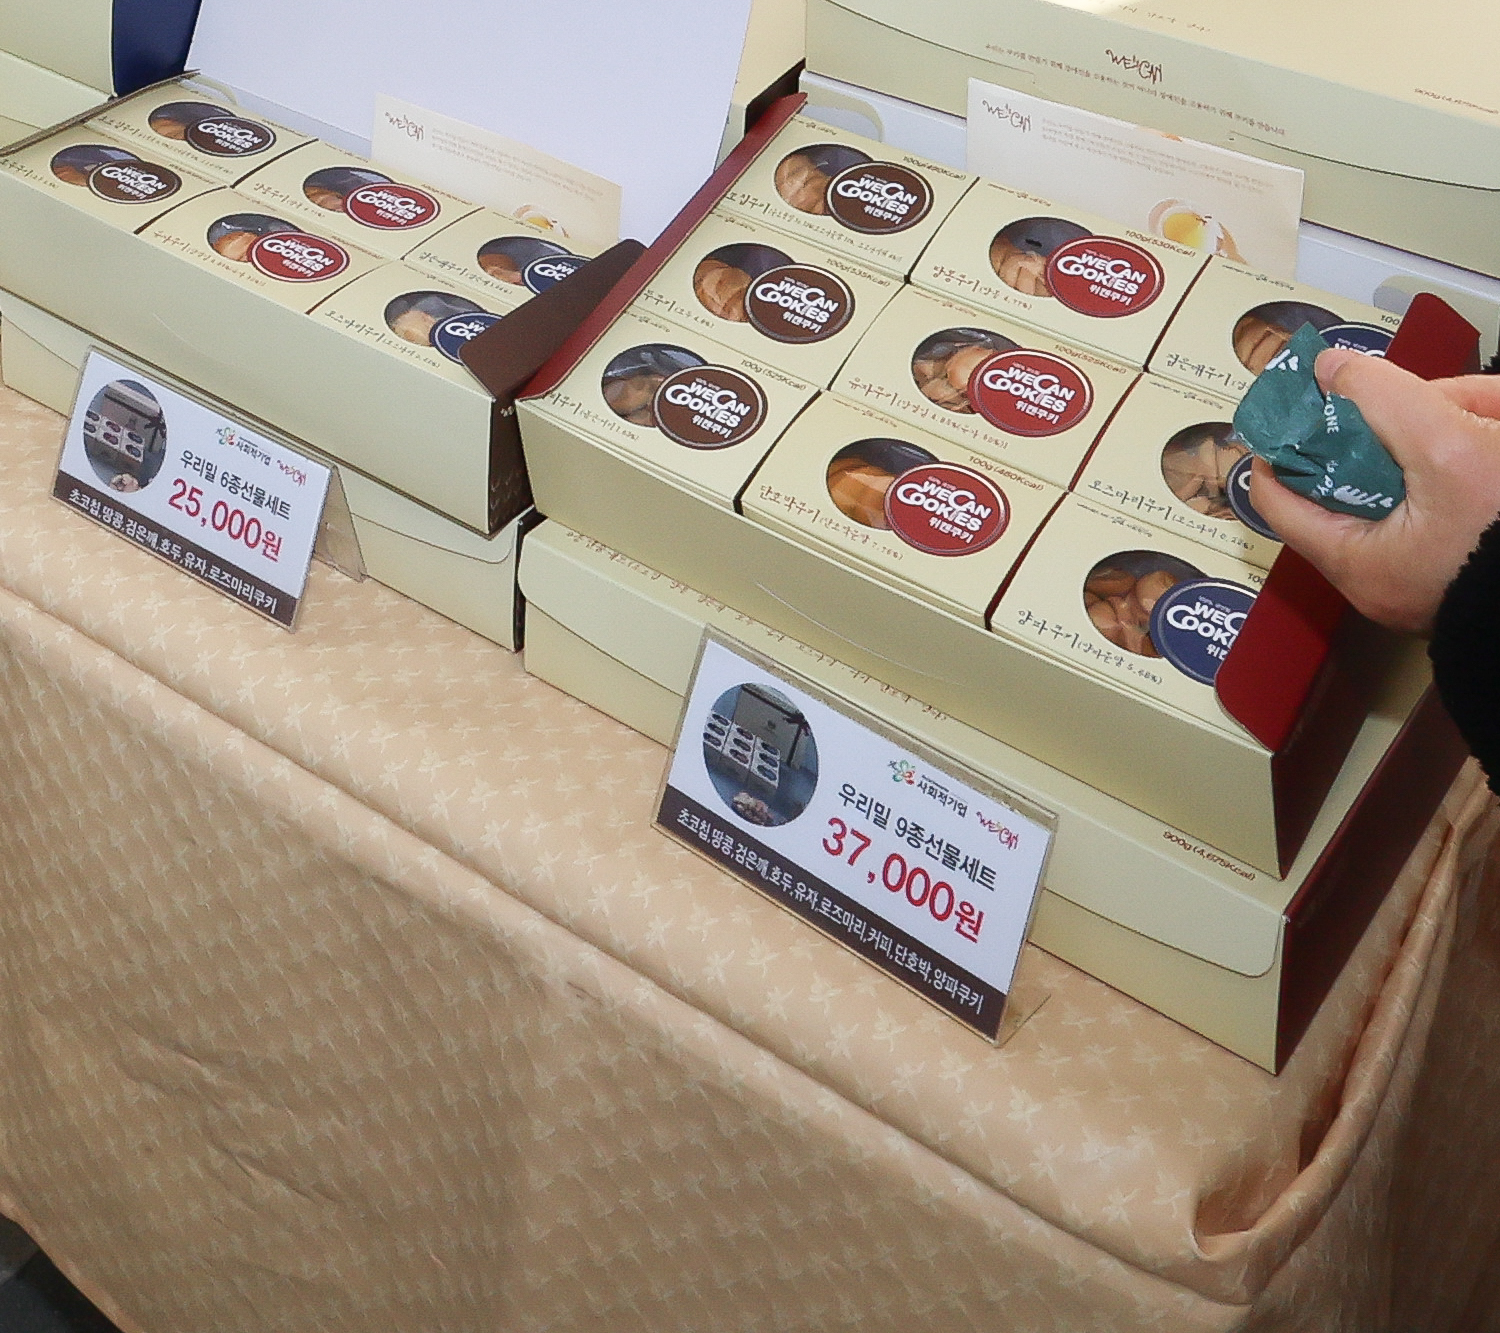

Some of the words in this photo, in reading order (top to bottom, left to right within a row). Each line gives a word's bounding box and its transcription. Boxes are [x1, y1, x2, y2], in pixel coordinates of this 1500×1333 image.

[356, 190, 417, 221] COOKIES
[836, 179, 910, 216] COOKIES
[263, 239, 326, 272] COOKIES
[1056, 255, 1140, 296] COOKIES
[1082, 252, 1147, 284] WECAN
[755, 282, 831, 324] COOKIES
[778, 279, 839, 314] WECAN
[689, 380, 751, 416] WECAN
[983, 369, 1068, 414] COOKIES
[1007, 364, 1075, 402] WECAN
[665, 384, 742, 428] COOKIES
[179, 448, 219, 484] 우리밀
[220, 470, 292, 521] 6종선물세트
[922, 480, 992, 521] WECAN
[167, 477, 283, 564] 25,000원
[896, 482, 983, 533] COOKIES
[916, 778, 969, 819] 사회적기업
[837, 781, 893, 828] 우리밀
[894, 816, 998, 892] 9종선물세트
[821, 817, 985, 944] 37,000원
[675, 807, 986, 1016] 초코칩,땅콩,검은깨,호두,유자,로즈마리,커피,단호박,양파쿠키
